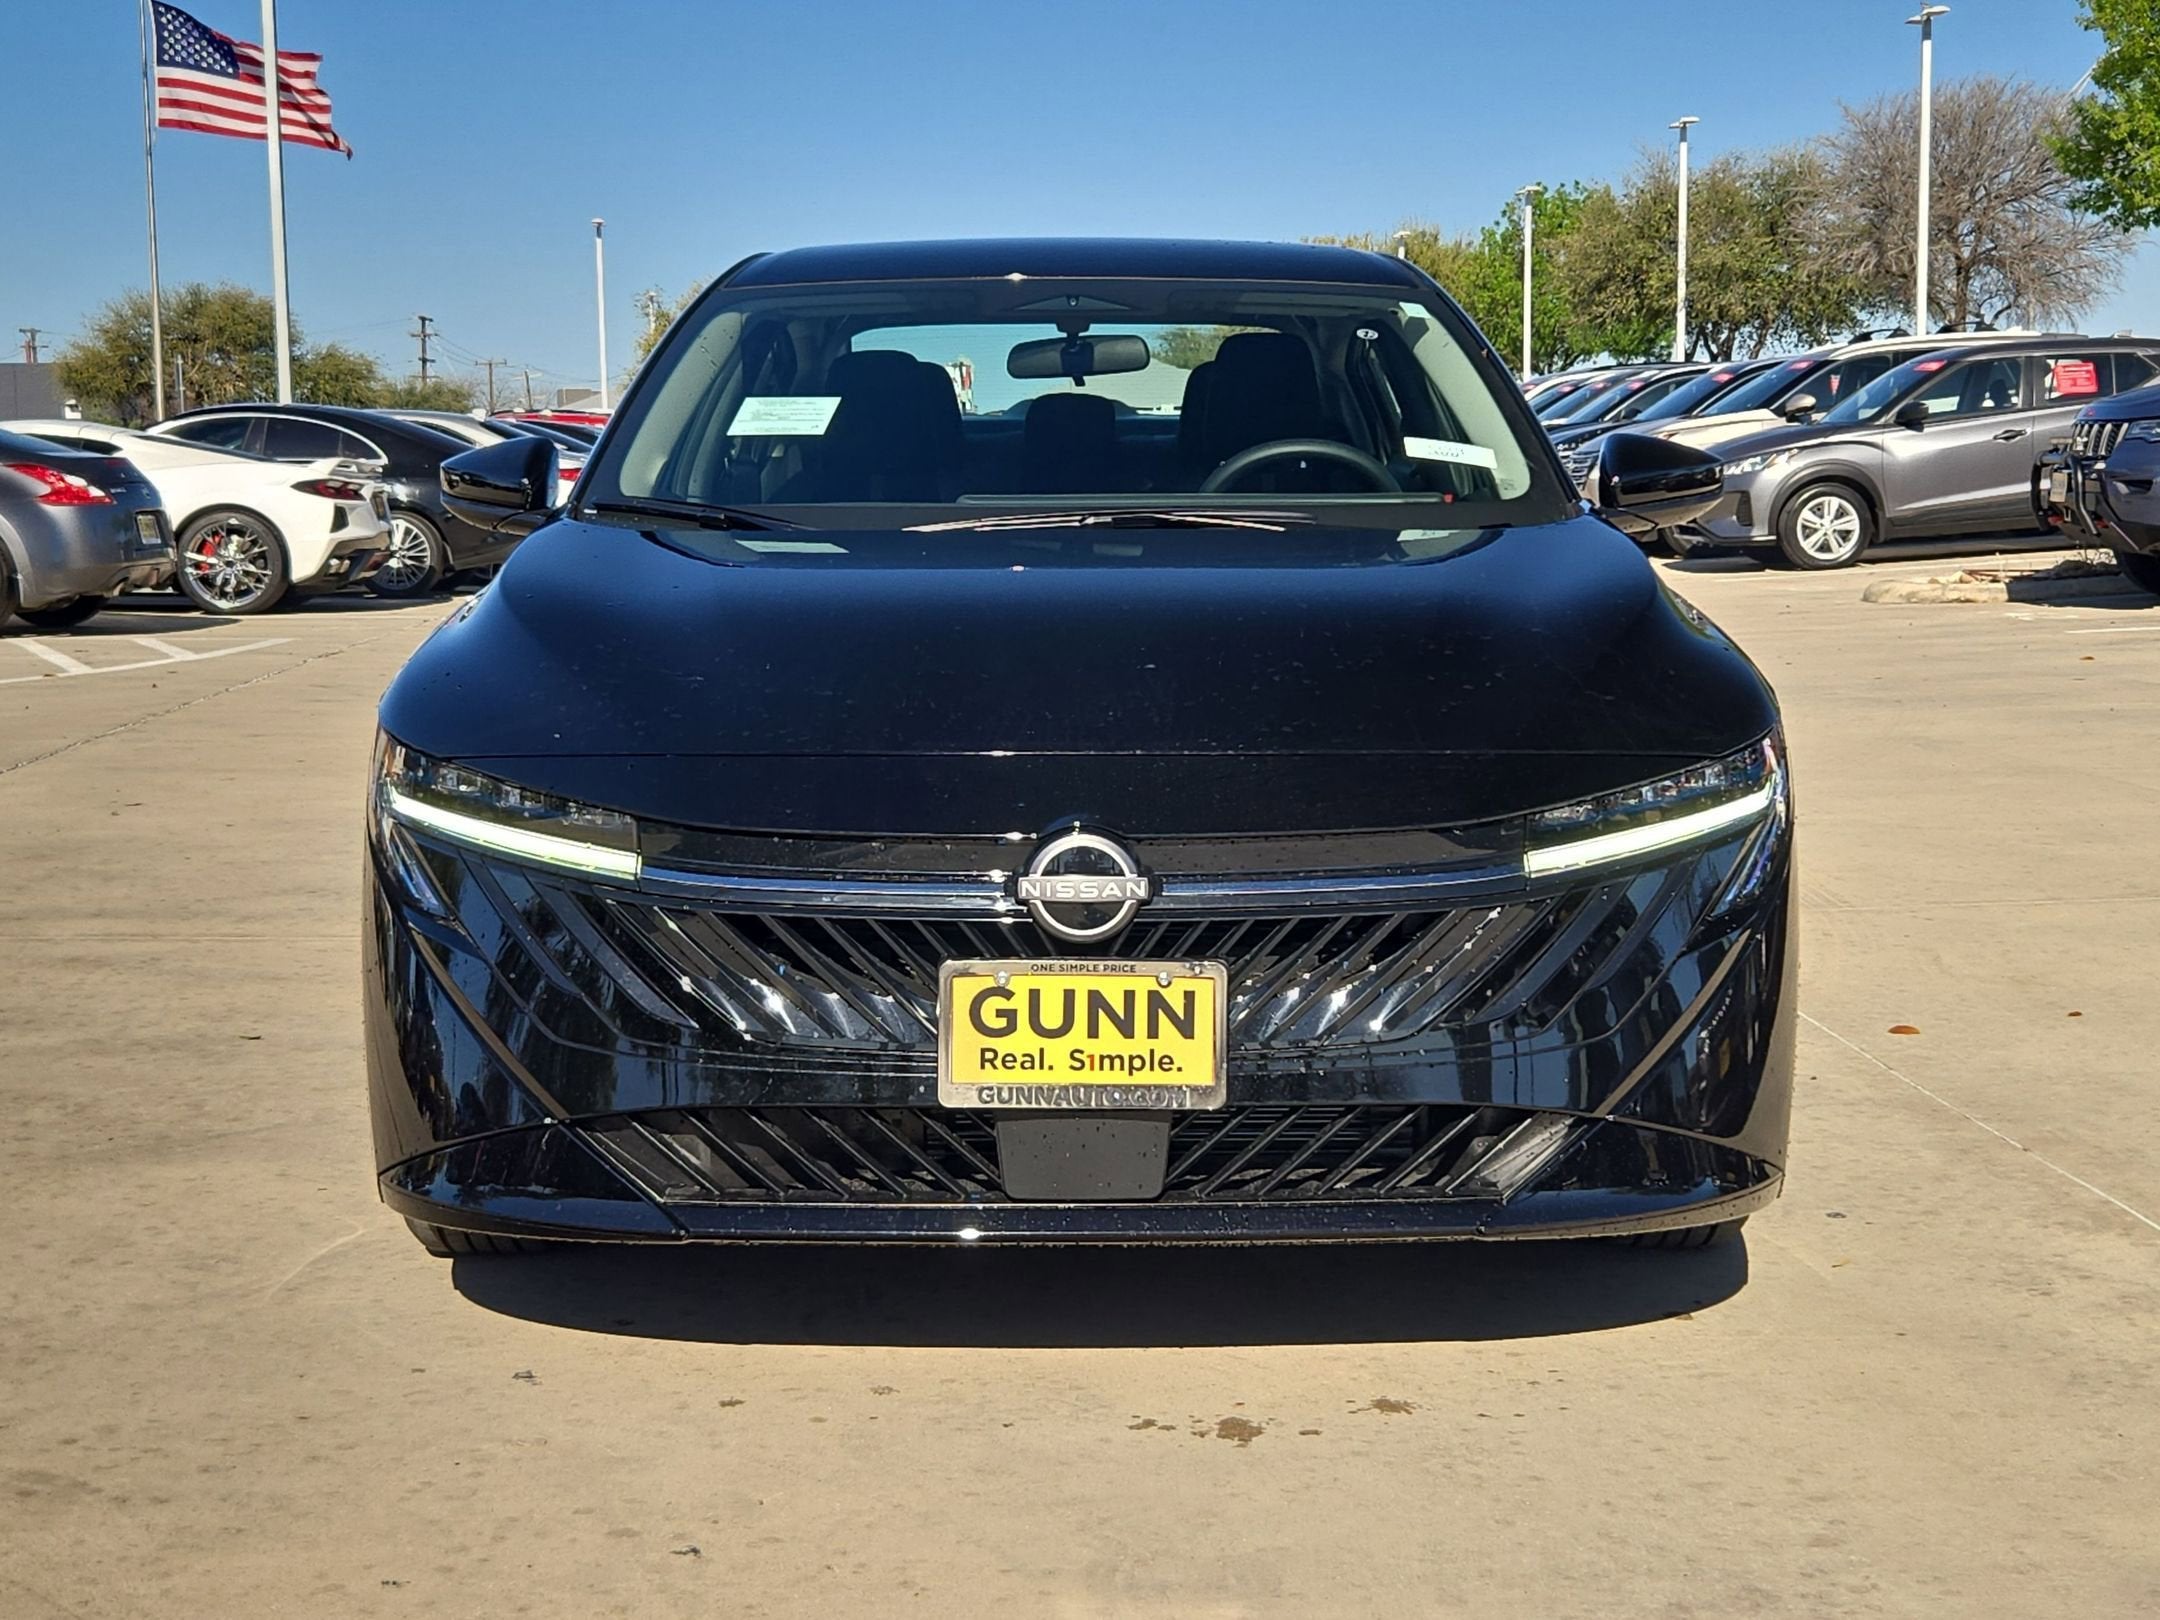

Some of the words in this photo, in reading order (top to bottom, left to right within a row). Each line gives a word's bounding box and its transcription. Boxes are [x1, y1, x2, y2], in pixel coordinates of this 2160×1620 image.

[1020, 880, 1146, 898] NISSAN
[1031, 963, 1055, 973] ONE
[1059, 963, 1099, 973] SIMPLE
[1103, 964, 1136, 974] PRICE
[969, 987, 1196, 1040] GUNN
[979, 1047, 1054, 1071] Real.
[977, 1085, 1190, 1107] GUNNAUTO.COM
